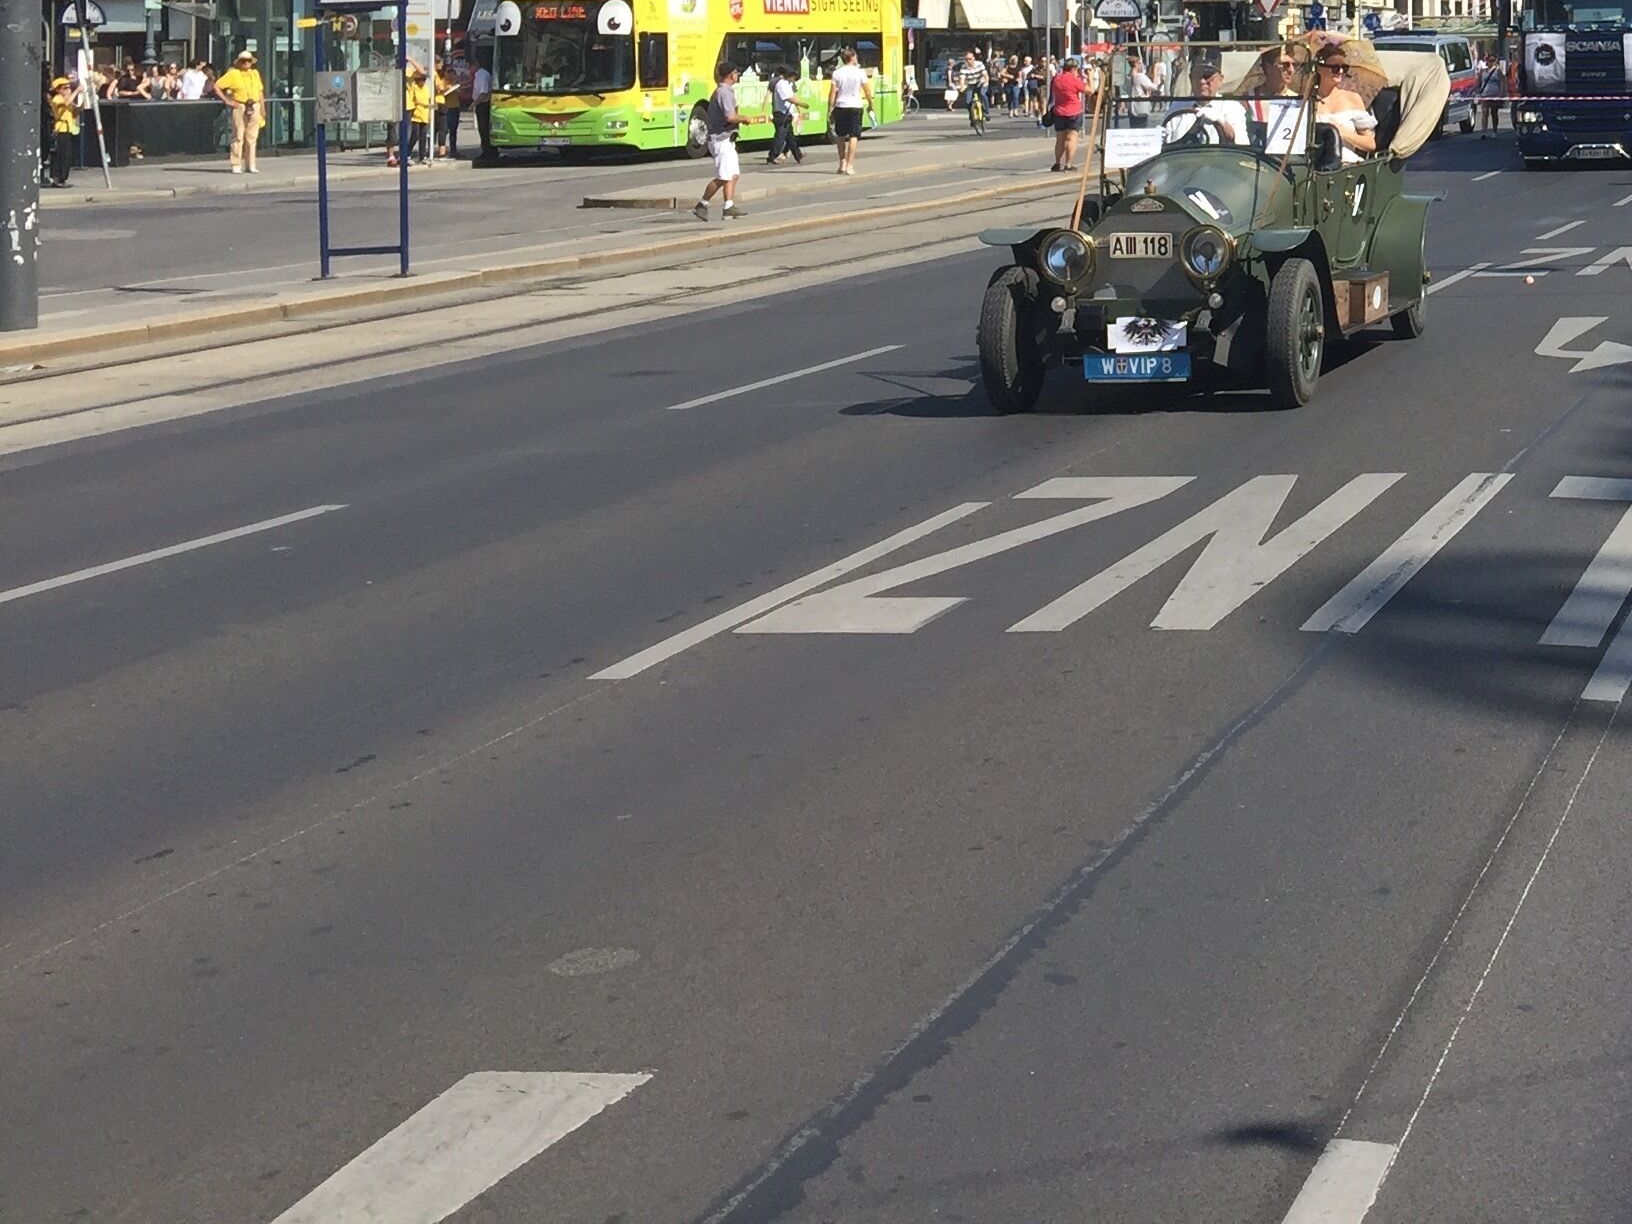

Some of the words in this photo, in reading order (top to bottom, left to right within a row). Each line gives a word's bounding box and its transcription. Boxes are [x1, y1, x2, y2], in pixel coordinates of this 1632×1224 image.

[1565, 40, 1622, 52] SCANIA
[1282, 128, 1293, 141] 2
[1142, 236, 1169, 256] 118
[1100, 359, 1114, 375] W
[1129, 358, 1157, 374] VIP
[1161, 359, 1173, 374] 8
